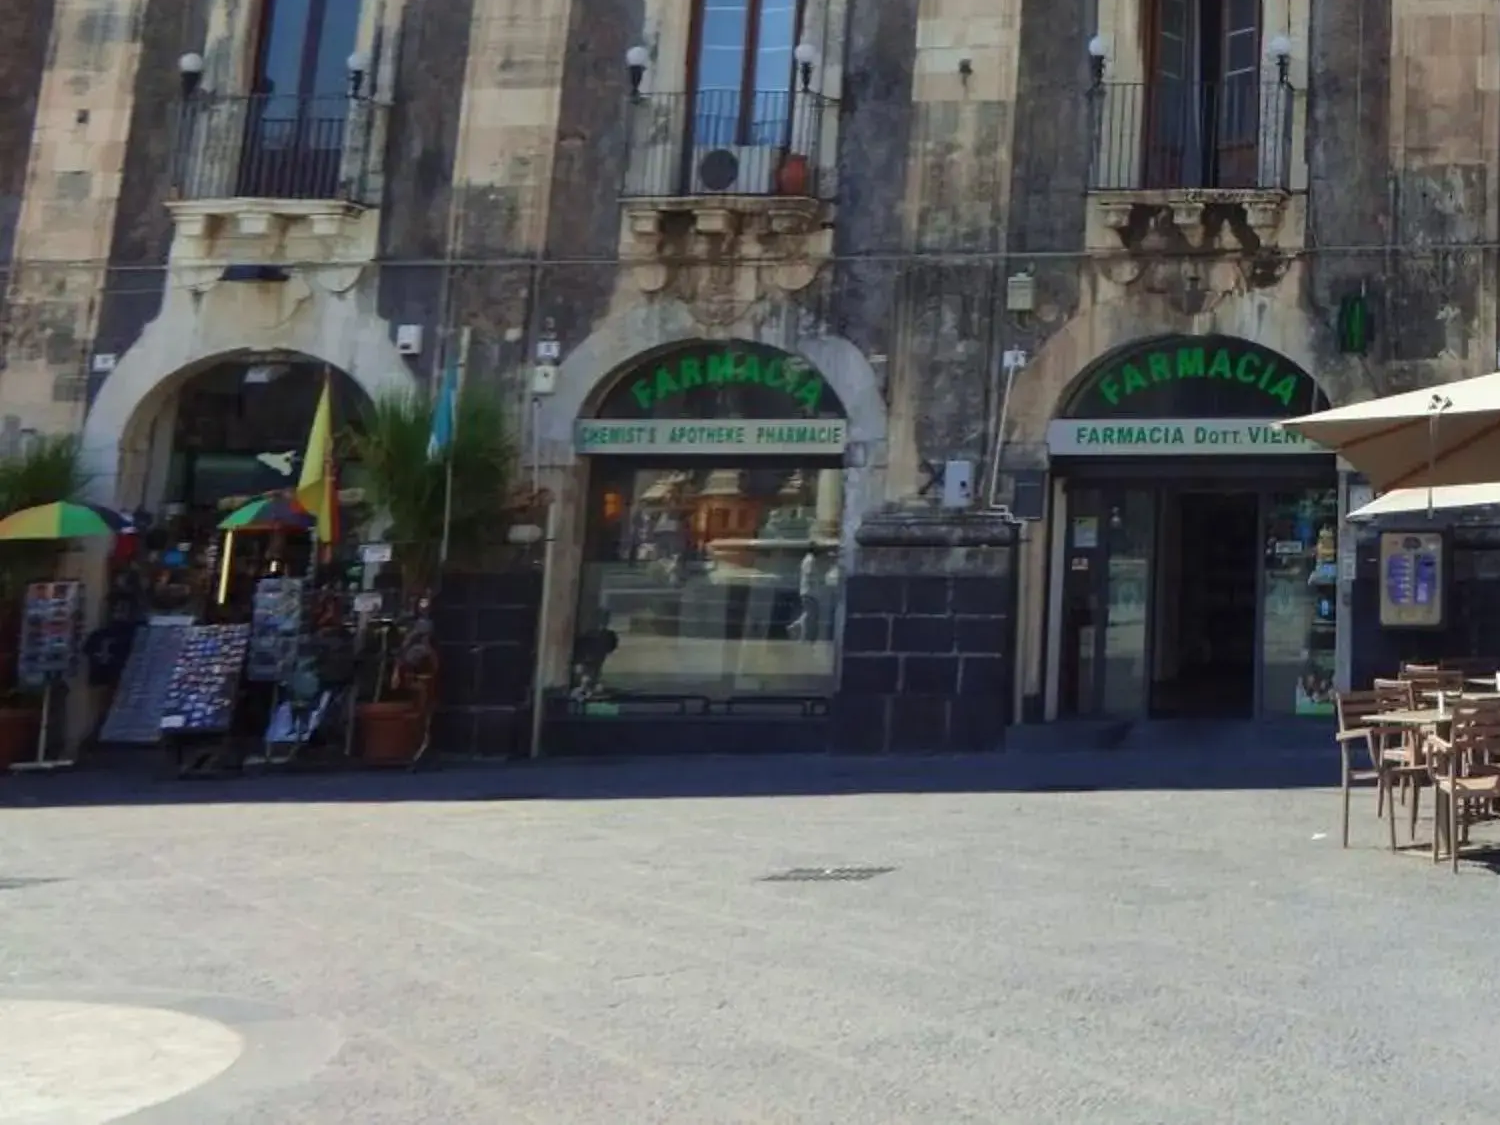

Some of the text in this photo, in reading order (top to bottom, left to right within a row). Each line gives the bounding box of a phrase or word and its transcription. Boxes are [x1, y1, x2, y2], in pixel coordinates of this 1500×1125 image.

[630, 352, 823, 409] FARMACIA
[1100, 347, 1297, 406] FARMACIA
[669, 426, 745, 444] APOTHEKE
[756, 426, 842, 444] PHARMACIE
[1076, 426, 1185, 444] FARMACIA
